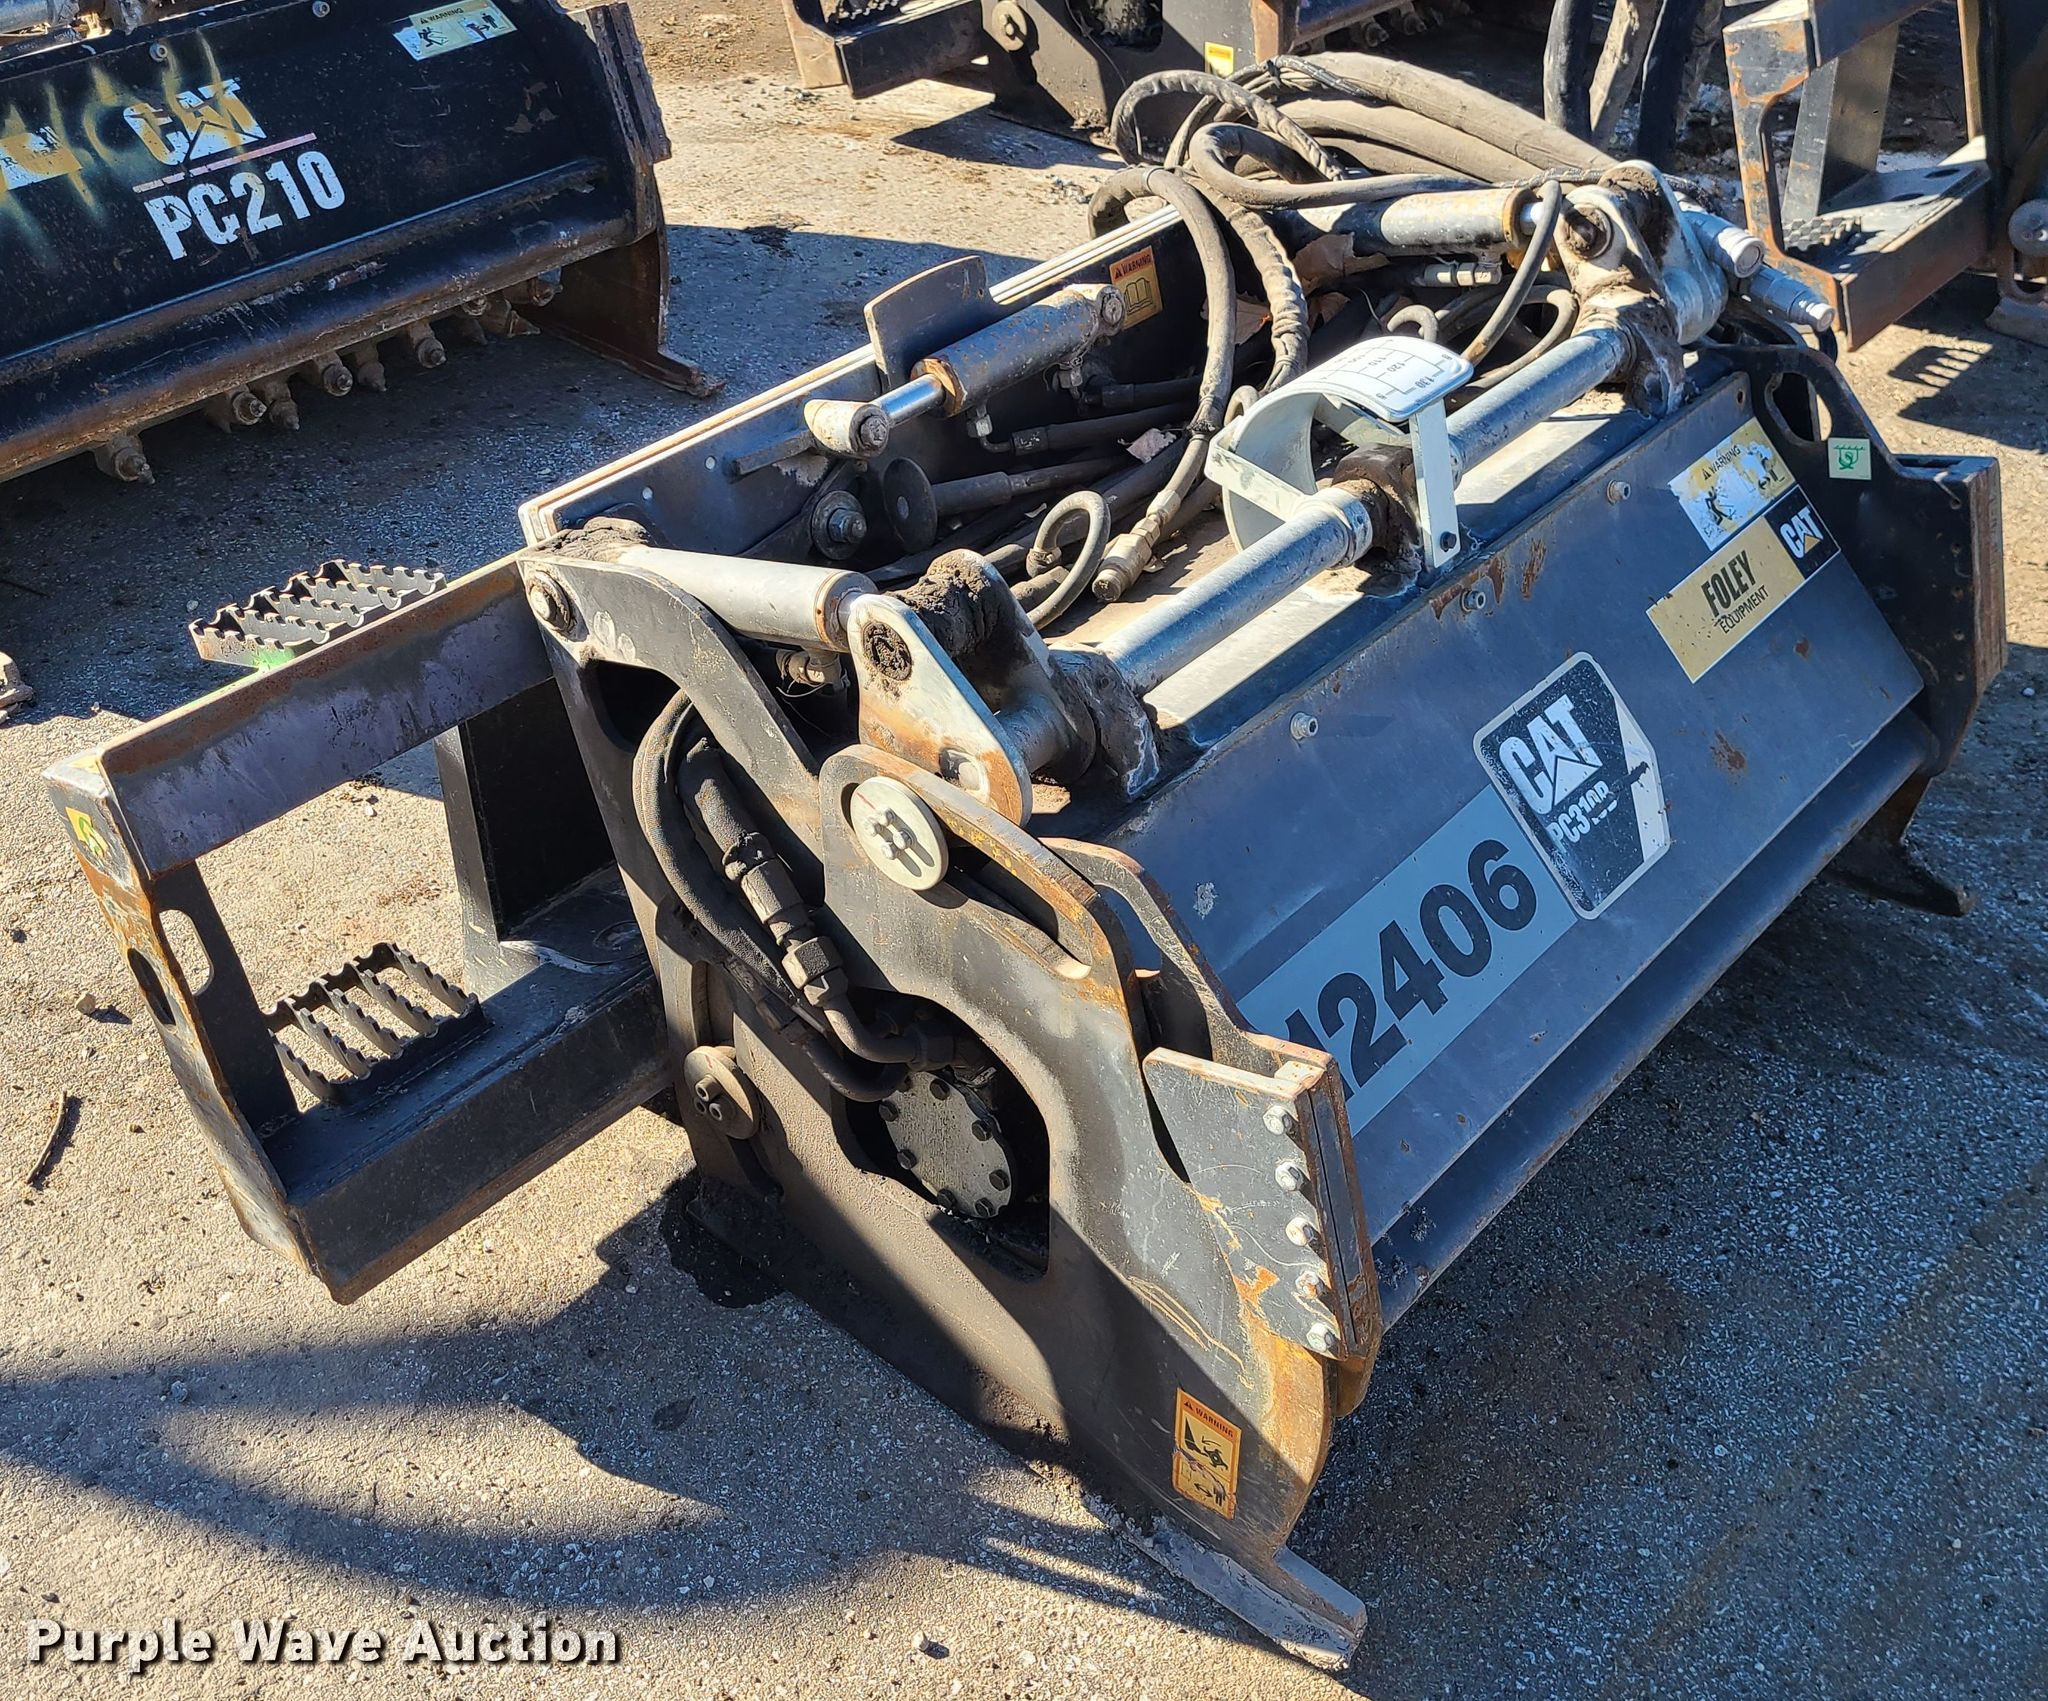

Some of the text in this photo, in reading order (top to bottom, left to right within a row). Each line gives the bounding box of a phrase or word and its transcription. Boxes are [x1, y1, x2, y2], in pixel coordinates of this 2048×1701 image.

[428, 7, 464, 22] WARNING
[123, 78, 268, 166] CAT
[144, 151, 346, 261] PC210
[1121, 254, 1152, 274] WARNING
[1414, 376, 1435, 389] 130
[1709, 445, 1741, 474] WARNING
[1780, 506, 1824, 559] CAT
[1701, 549, 1756, 618] FOLEY
[1720, 585, 1769, 634] EQUIPMENT
[1499, 694, 1603, 815] CAT
[1195, 1407, 1234, 1438] WARNING
